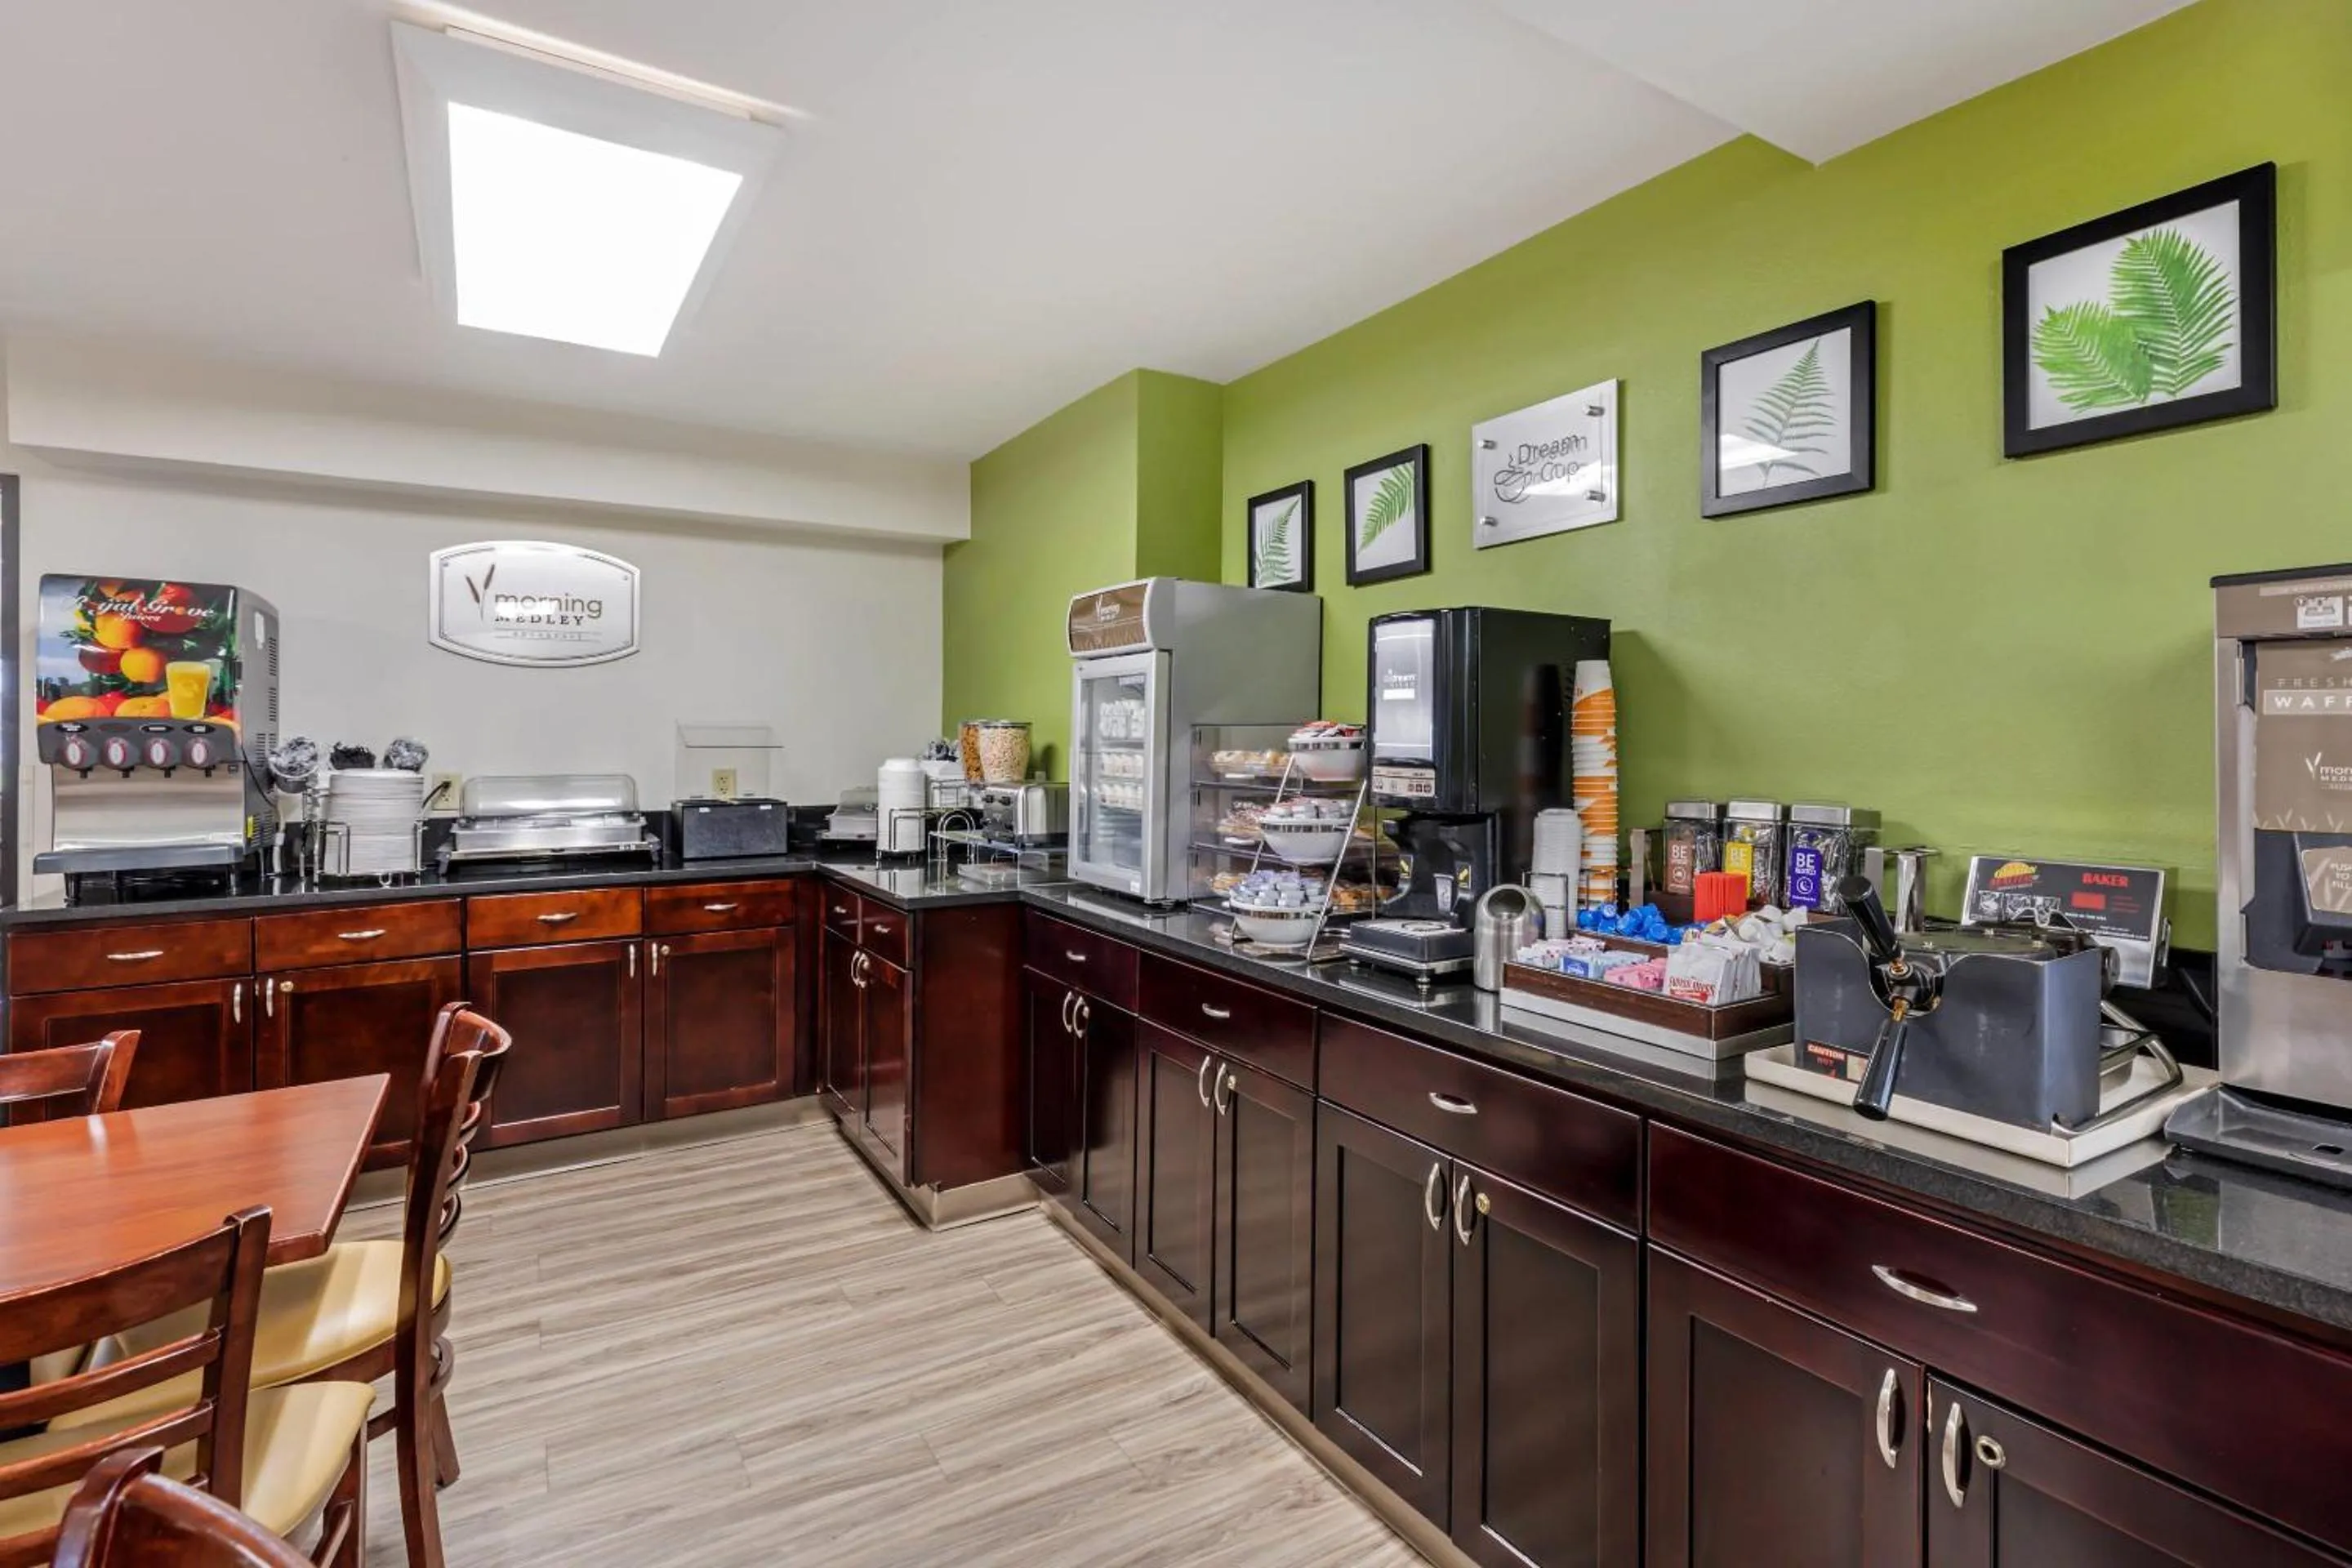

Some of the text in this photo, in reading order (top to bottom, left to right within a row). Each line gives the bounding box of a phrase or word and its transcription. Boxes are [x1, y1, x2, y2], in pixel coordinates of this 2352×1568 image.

[1518, 434, 1585, 466] Dream
[1672, 844, 1688, 859] BE
[1796, 852, 1815, 868] BE
[2081, 872, 2129, 888] BAKER
[1807, 1043, 1846, 1061] CAUTION
